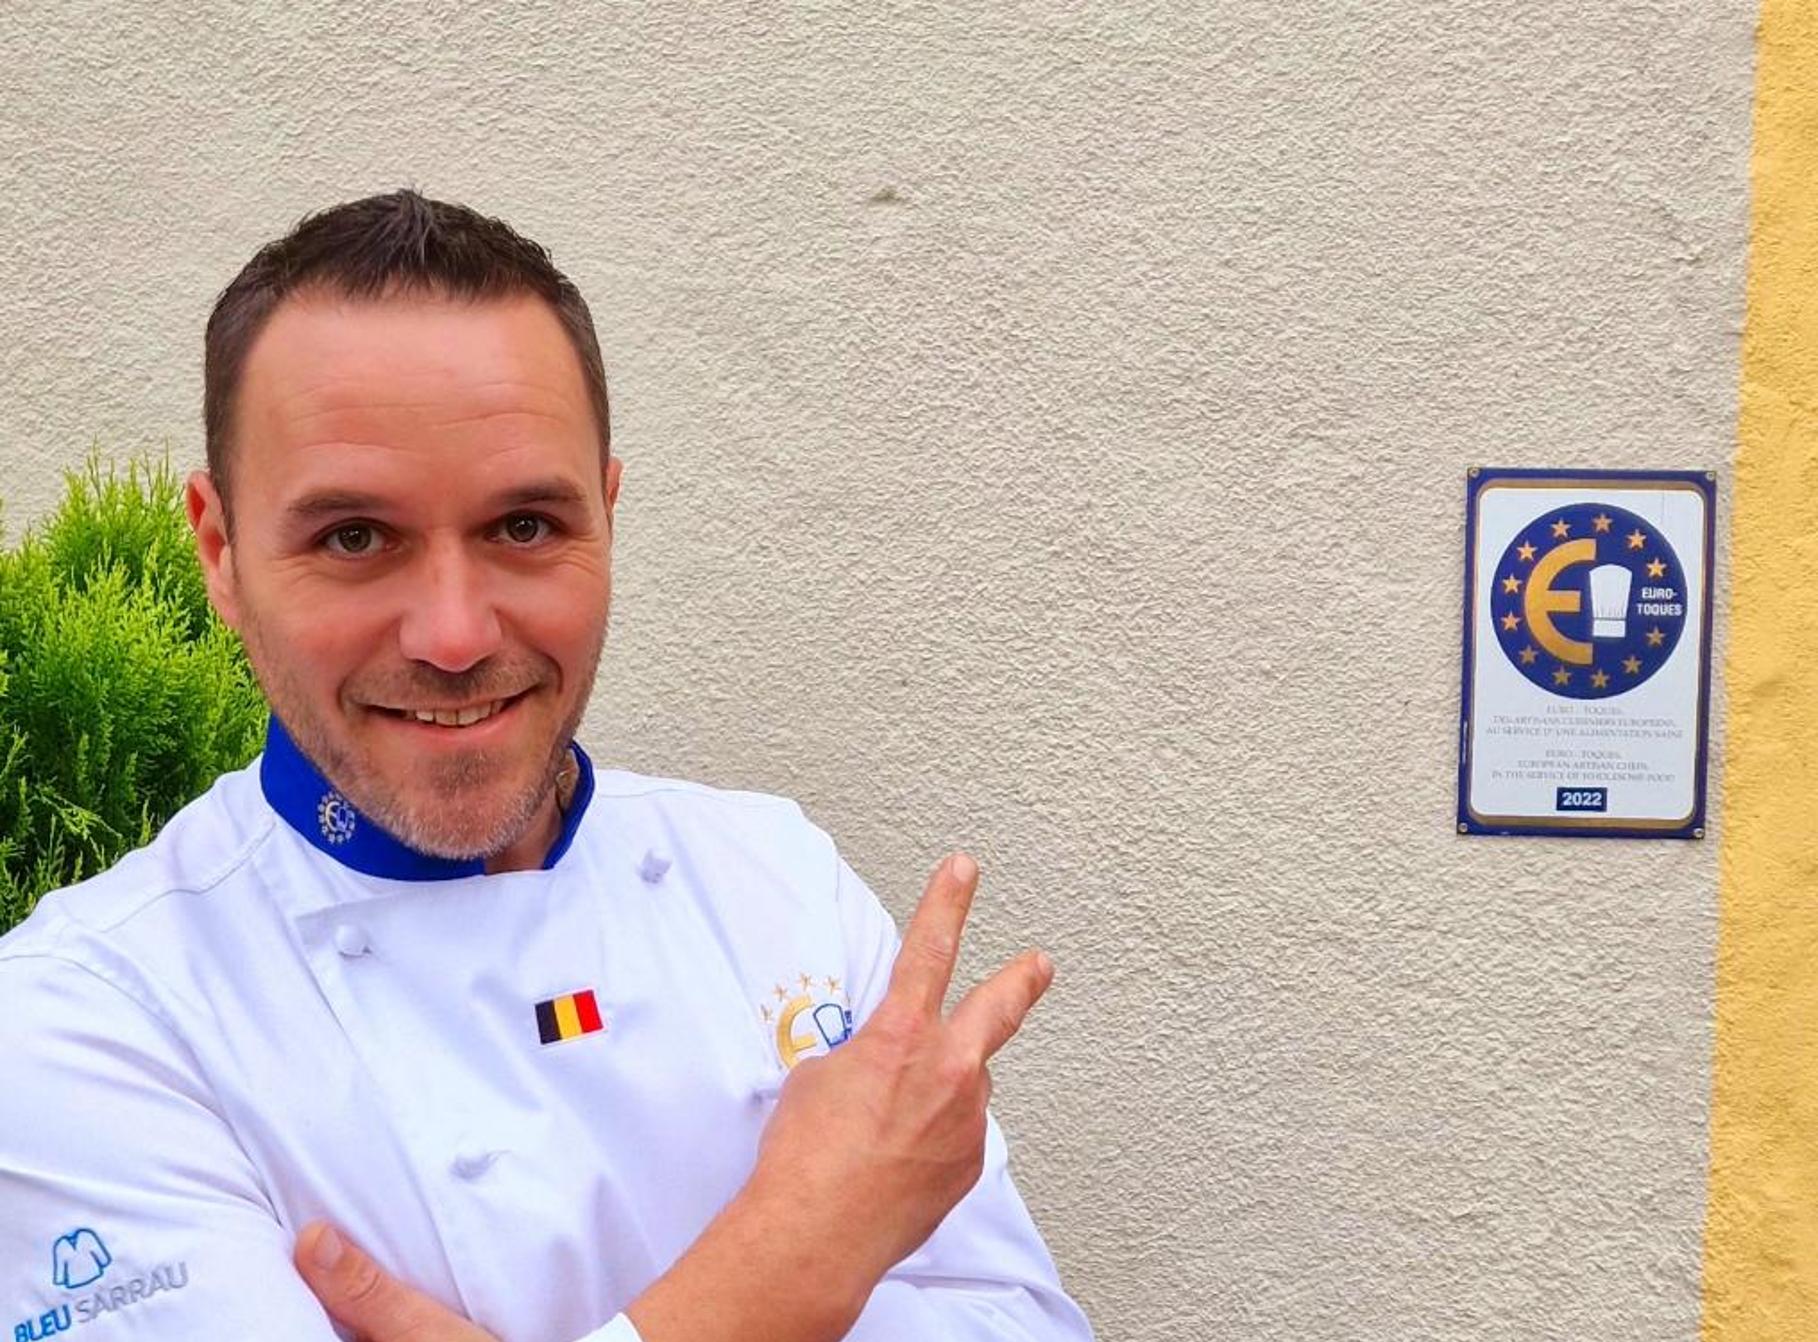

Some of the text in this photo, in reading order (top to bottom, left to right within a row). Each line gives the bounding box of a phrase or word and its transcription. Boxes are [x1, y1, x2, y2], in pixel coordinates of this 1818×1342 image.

[1642, 587, 1678, 599] EURO-
[1636, 603, 1683, 616] TOQUES
[1561, 792, 1602, 806] 2022
[74, 1261, 190, 1324] SARRAU
